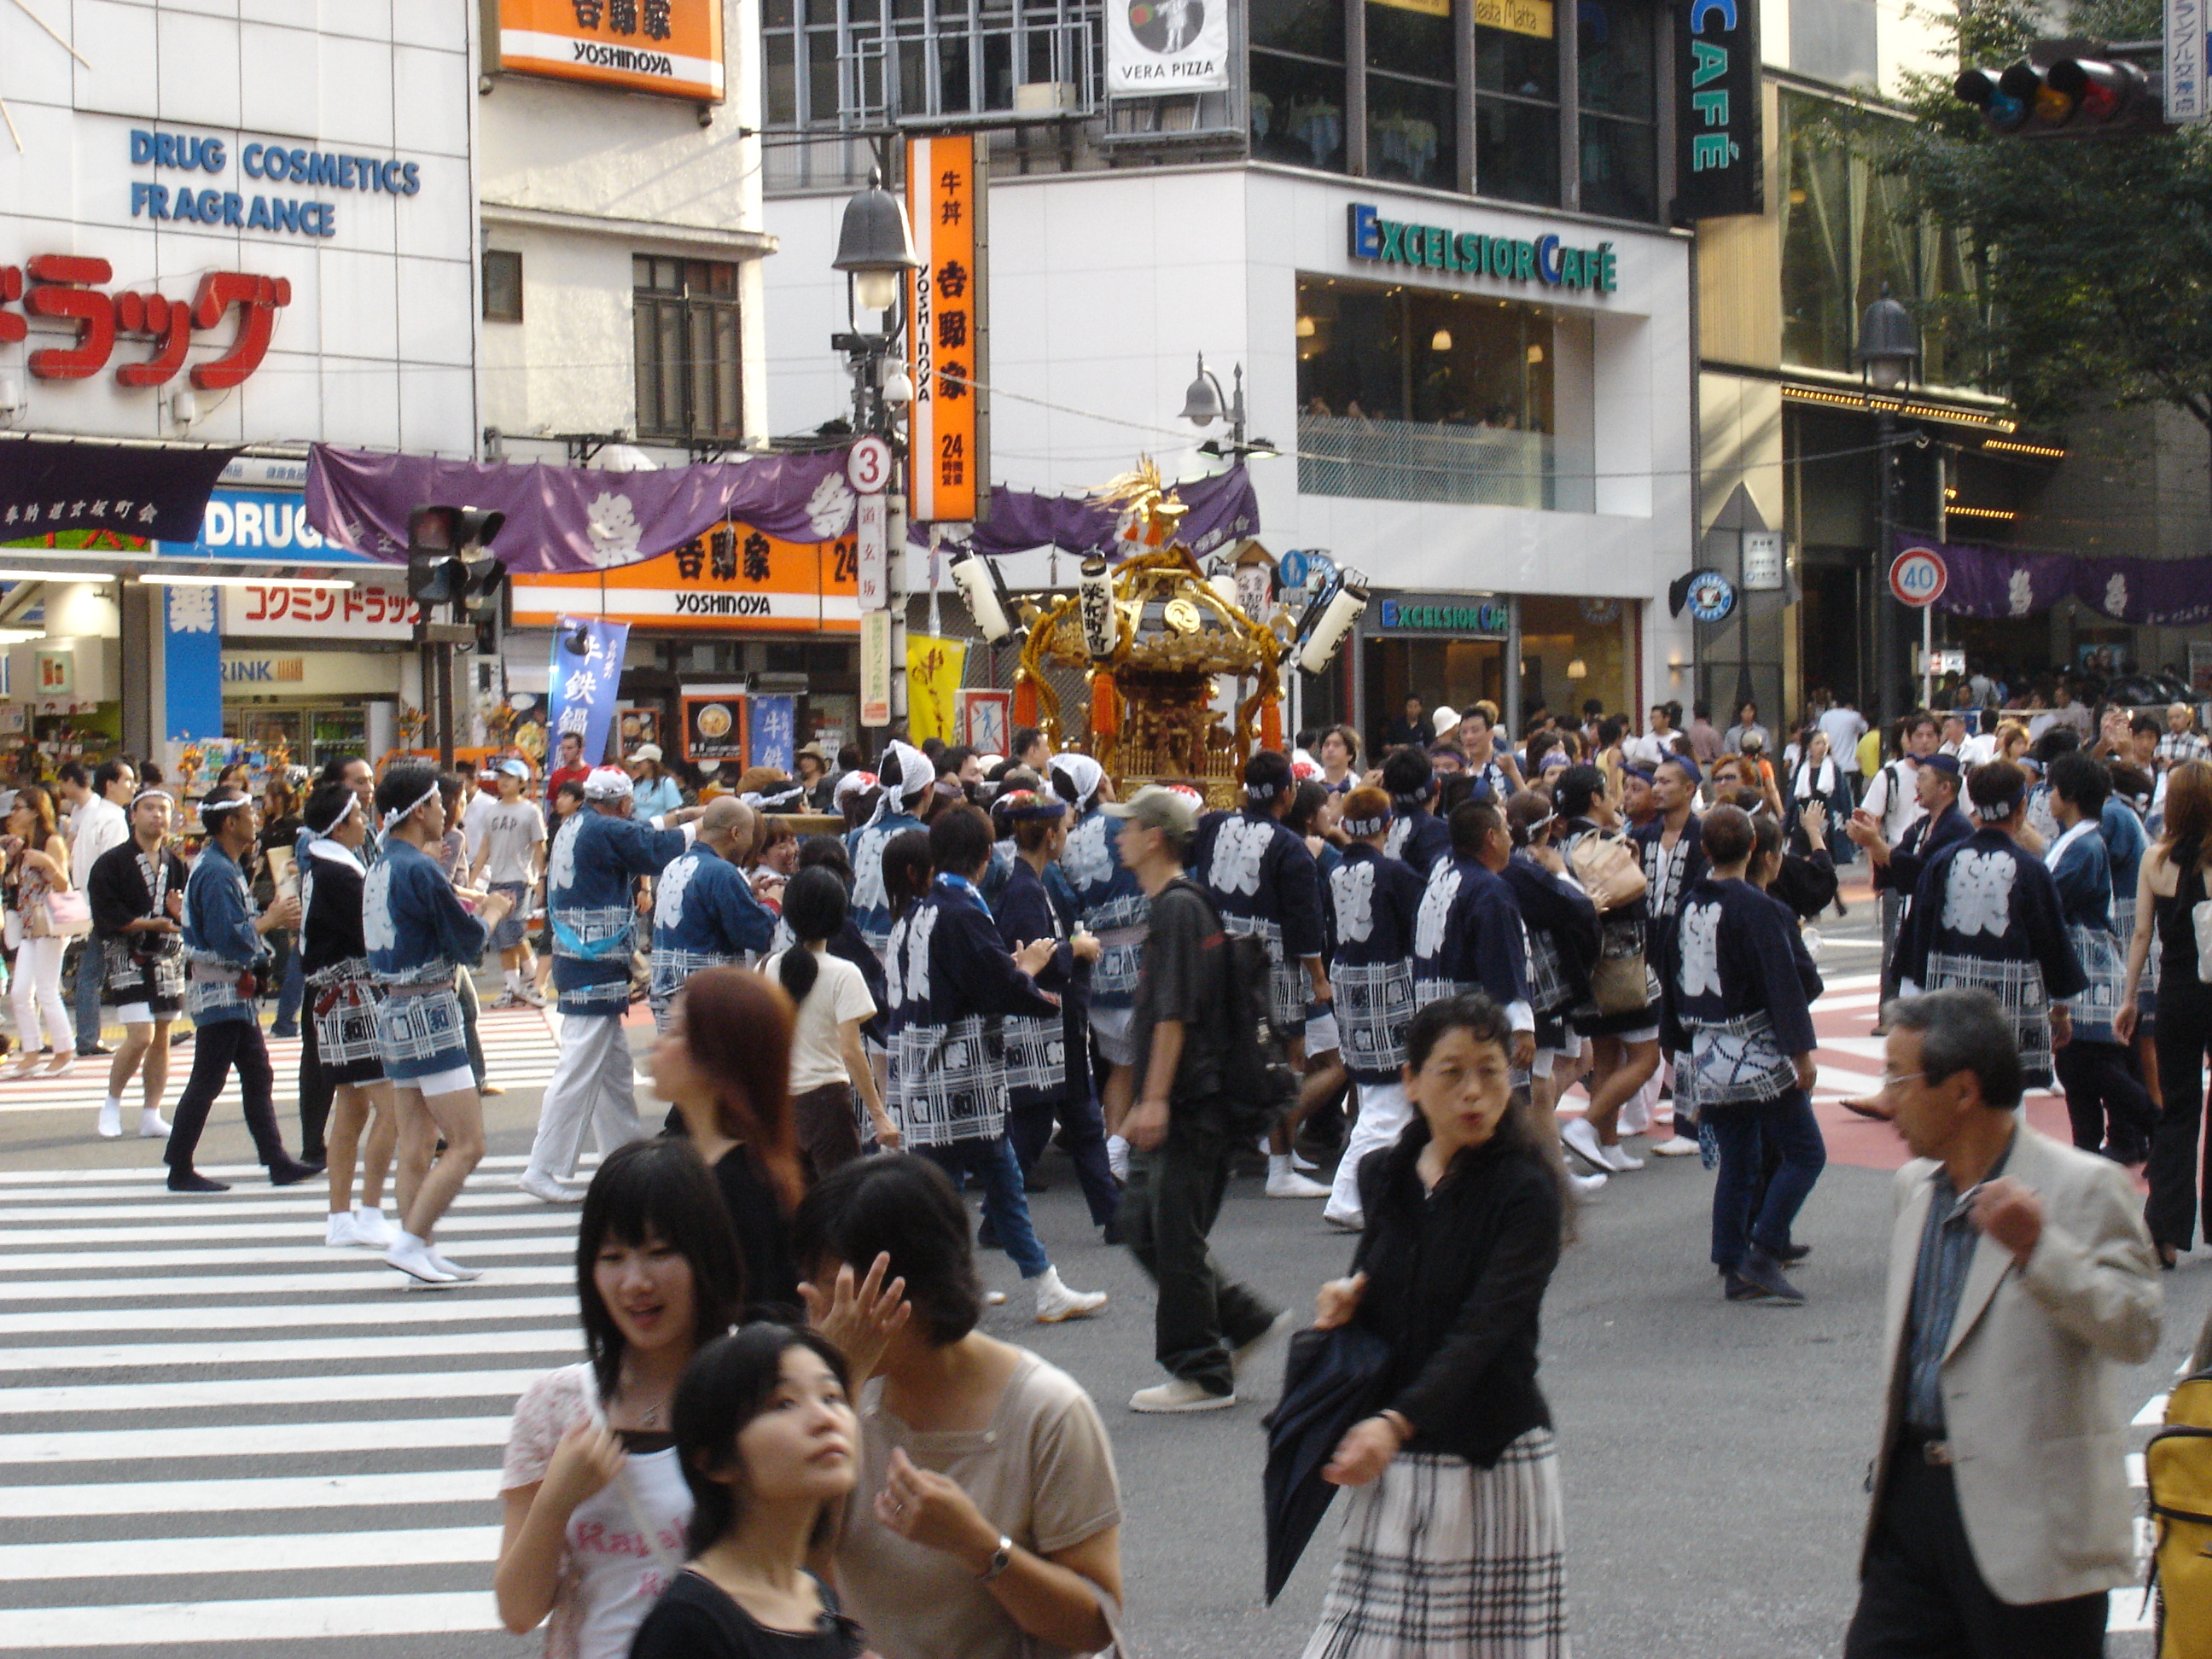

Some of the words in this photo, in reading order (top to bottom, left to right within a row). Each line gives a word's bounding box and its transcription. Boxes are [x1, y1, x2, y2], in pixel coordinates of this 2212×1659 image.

[573, 41, 673, 76] YOSHINOYA
[1122, 63, 1166, 79] VERA
[1172, 60, 1215, 77] PIZZA
[1691, 0, 1739, 172] CAFÉ
[131, 130, 226, 173] DRUG
[243, 143, 421, 196] COSMETICS
[131, 182, 336, 237] FRAGRANCE
[1348, 203, 1535, 281] EXCELSIOR
[1535, 232, 1617, 292] CAFÉ
[859, 446, 879, 484] 3
[205, 500, 344, 550] DRUG
[1903, 565, 1935, 590] 40
[675, 593, 771, 615] YOSHINOYA
[1381, 598, 1479, 629] EXCELSIOR
[221, 660, 273, 682] RINK
[491, 815, 518, 833] GAP
